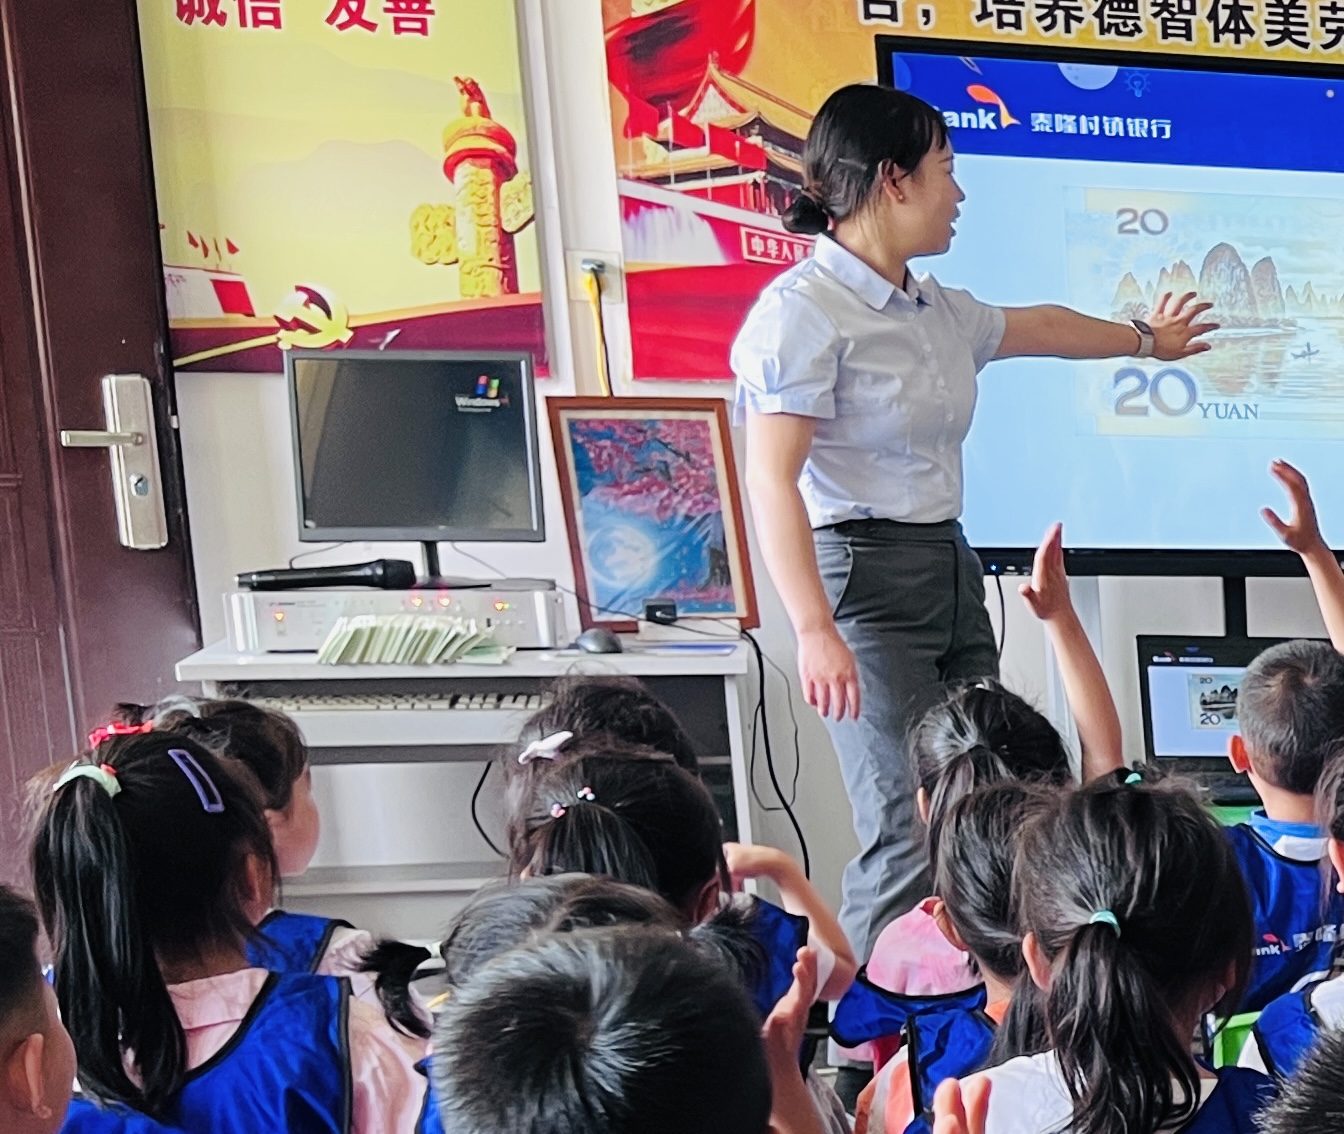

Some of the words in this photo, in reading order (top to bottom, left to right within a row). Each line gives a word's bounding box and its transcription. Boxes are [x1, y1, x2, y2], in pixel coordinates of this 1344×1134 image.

[942, 108, 998, 130] ank
[1116, 207, 1169, 235] 20
[1113, 367, 1199, 416] 20
[1197, 403, 1259, 420] YUAN
